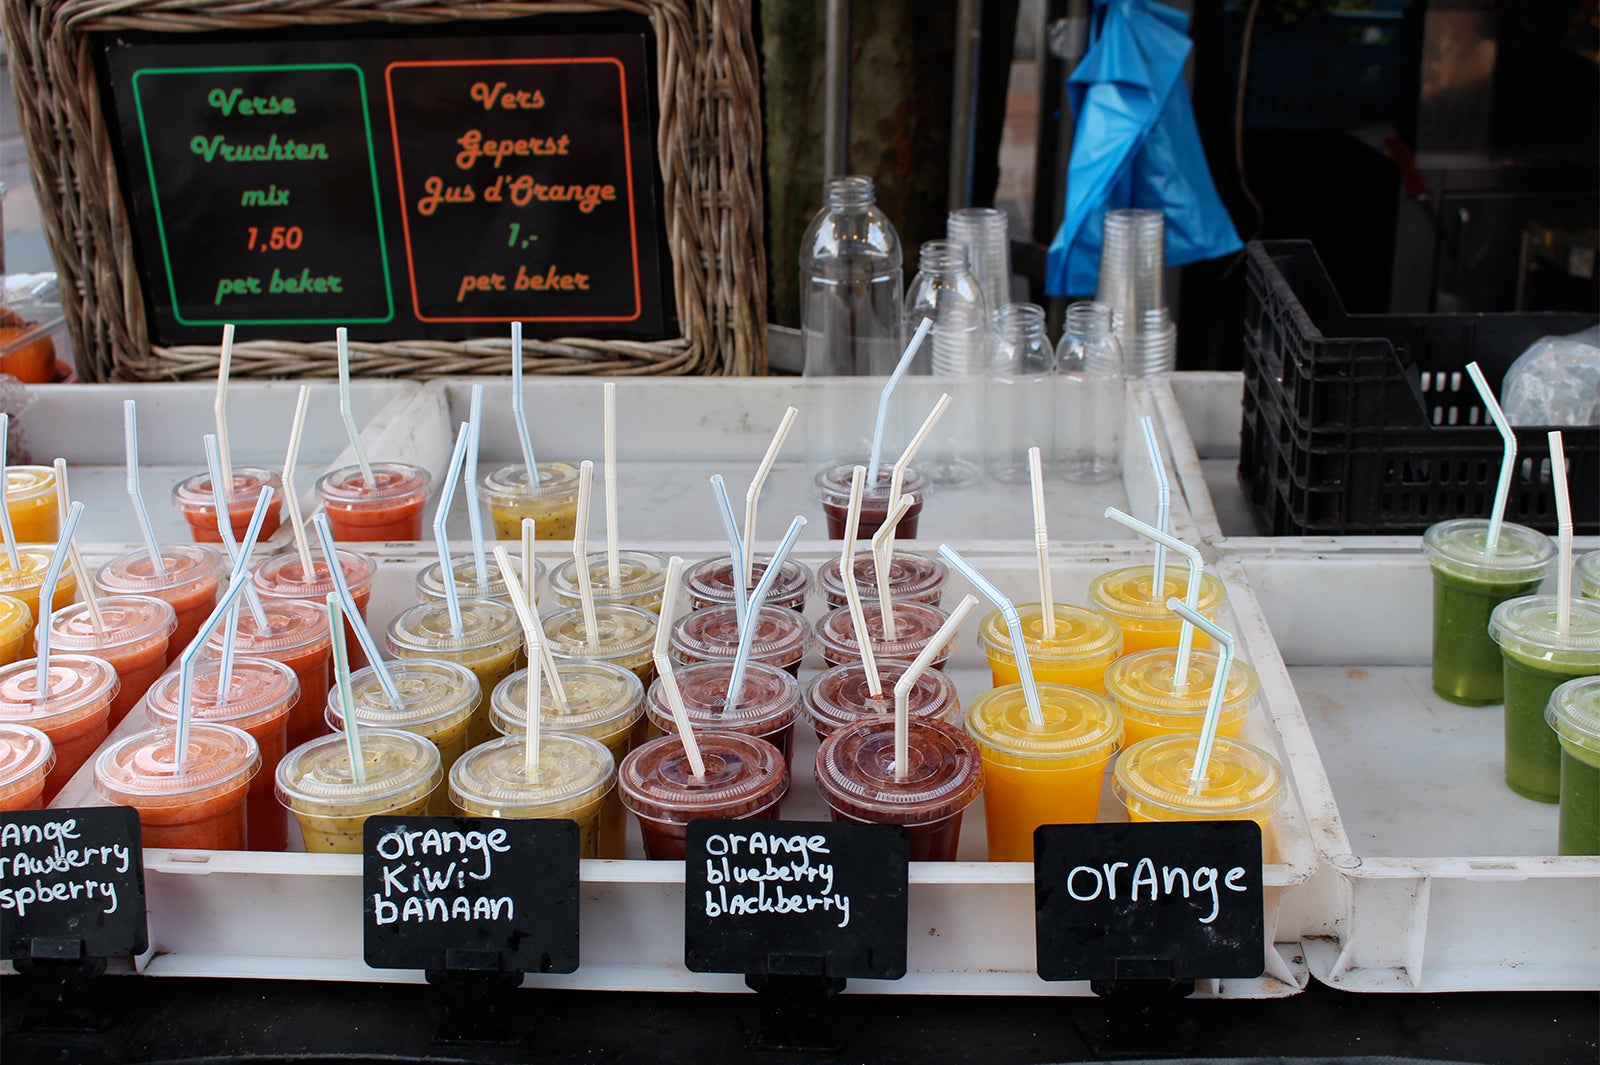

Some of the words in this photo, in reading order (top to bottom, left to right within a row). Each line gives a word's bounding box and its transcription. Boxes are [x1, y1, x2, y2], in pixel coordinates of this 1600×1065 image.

[208, 88, 296, 116] Verse
[470, 82, 545, 110] Vers
[190, 134, 329, 163] Vruchten
[456, 129, 570, 170] Geperst
[241, 185, 290, 206] mix
[417, 176, 475, 215] Jus
[483, 175, 616, 213] d'Orange
[247, 226, 303, 253] 1,50
[507, 223, 538, 249] 1,-
[214, 276, 262, 306] per
[268, 268, 343, 294] beker
[457, 274, 506, 302] per
[513, 265, 590, 291] beker
[706, 857, 833, 895] blueberry
